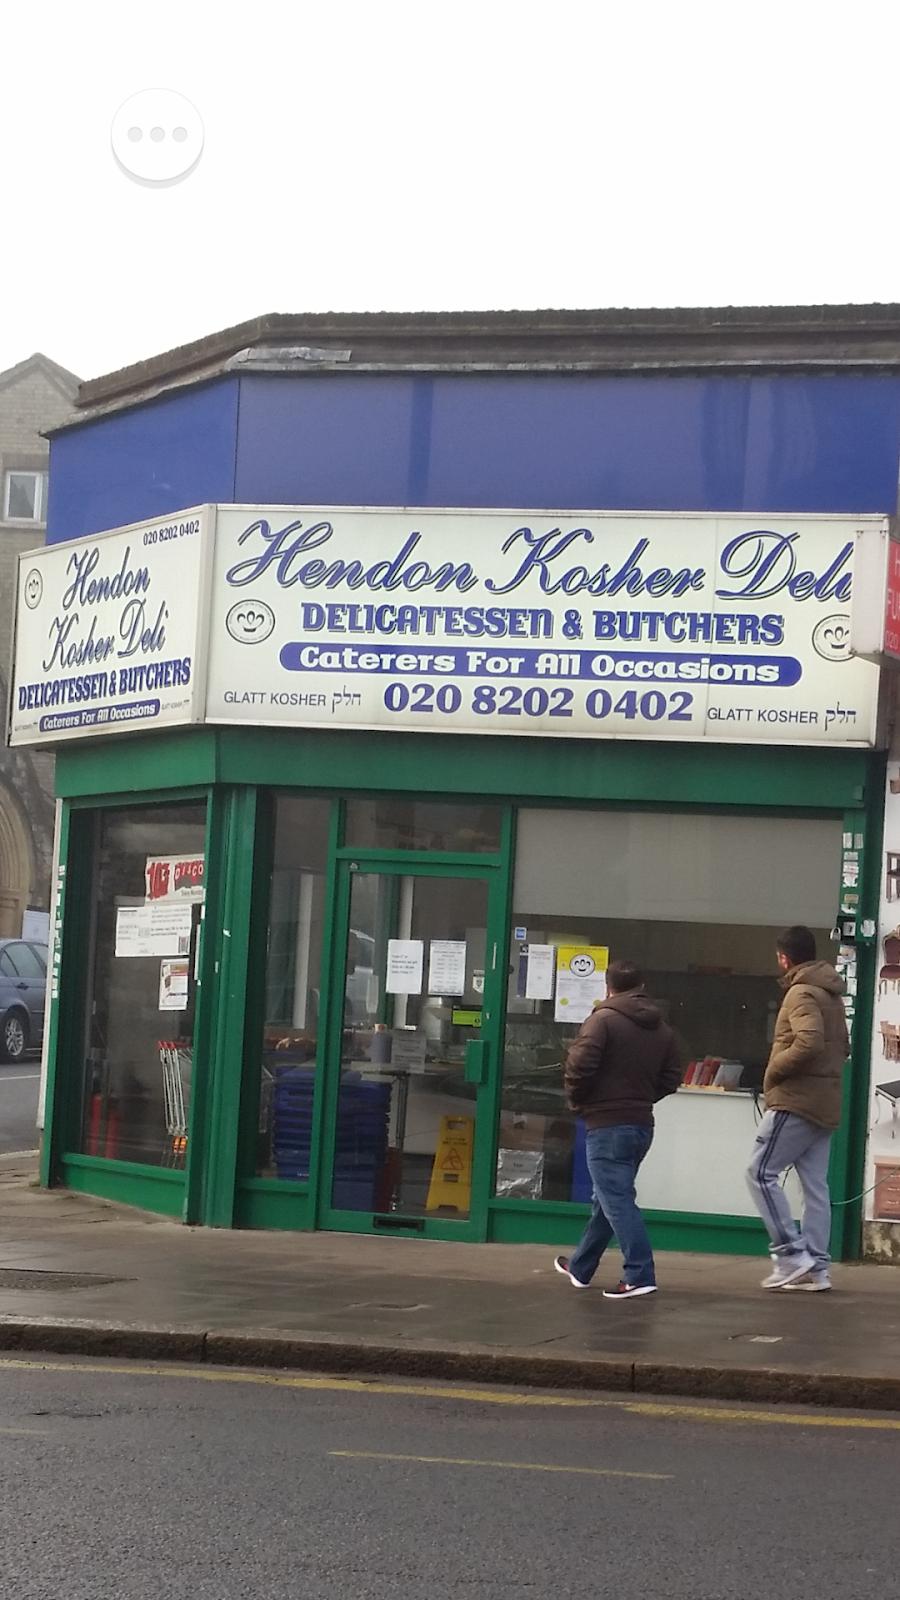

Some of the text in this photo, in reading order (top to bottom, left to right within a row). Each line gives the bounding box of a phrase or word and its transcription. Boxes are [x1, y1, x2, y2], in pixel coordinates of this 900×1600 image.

[143, 519, 200, 546] 020 8202 0402
[62, 546, 151, 610] Hendon
[225, 519, 478, 593] Hendon
[484, 527, 706, 598] Kosher
[42, 612, 116, 672] Kosher
[117, 598, 169, 659] Deli
[301, 602, 554, 639] DELICATESSEN
[562, 609, 583, 640] &
[593, 610, 785, 645] BUTCHERS
[18, 657, 192, 711] DELICATESSEN & BUTCHERS
[300, 646, 780, 683] Caterers For All Occasions
[43, 715, 80, 730] Caterers
[81, 710, 96, 725] For
[97, 708, 110, 722] All
[110, 703, 156, 721] Occasions
[223, 682, 857, 732] GLATT KOSHER חלק 020 8202 0402 GLATT KOSHER חלק
